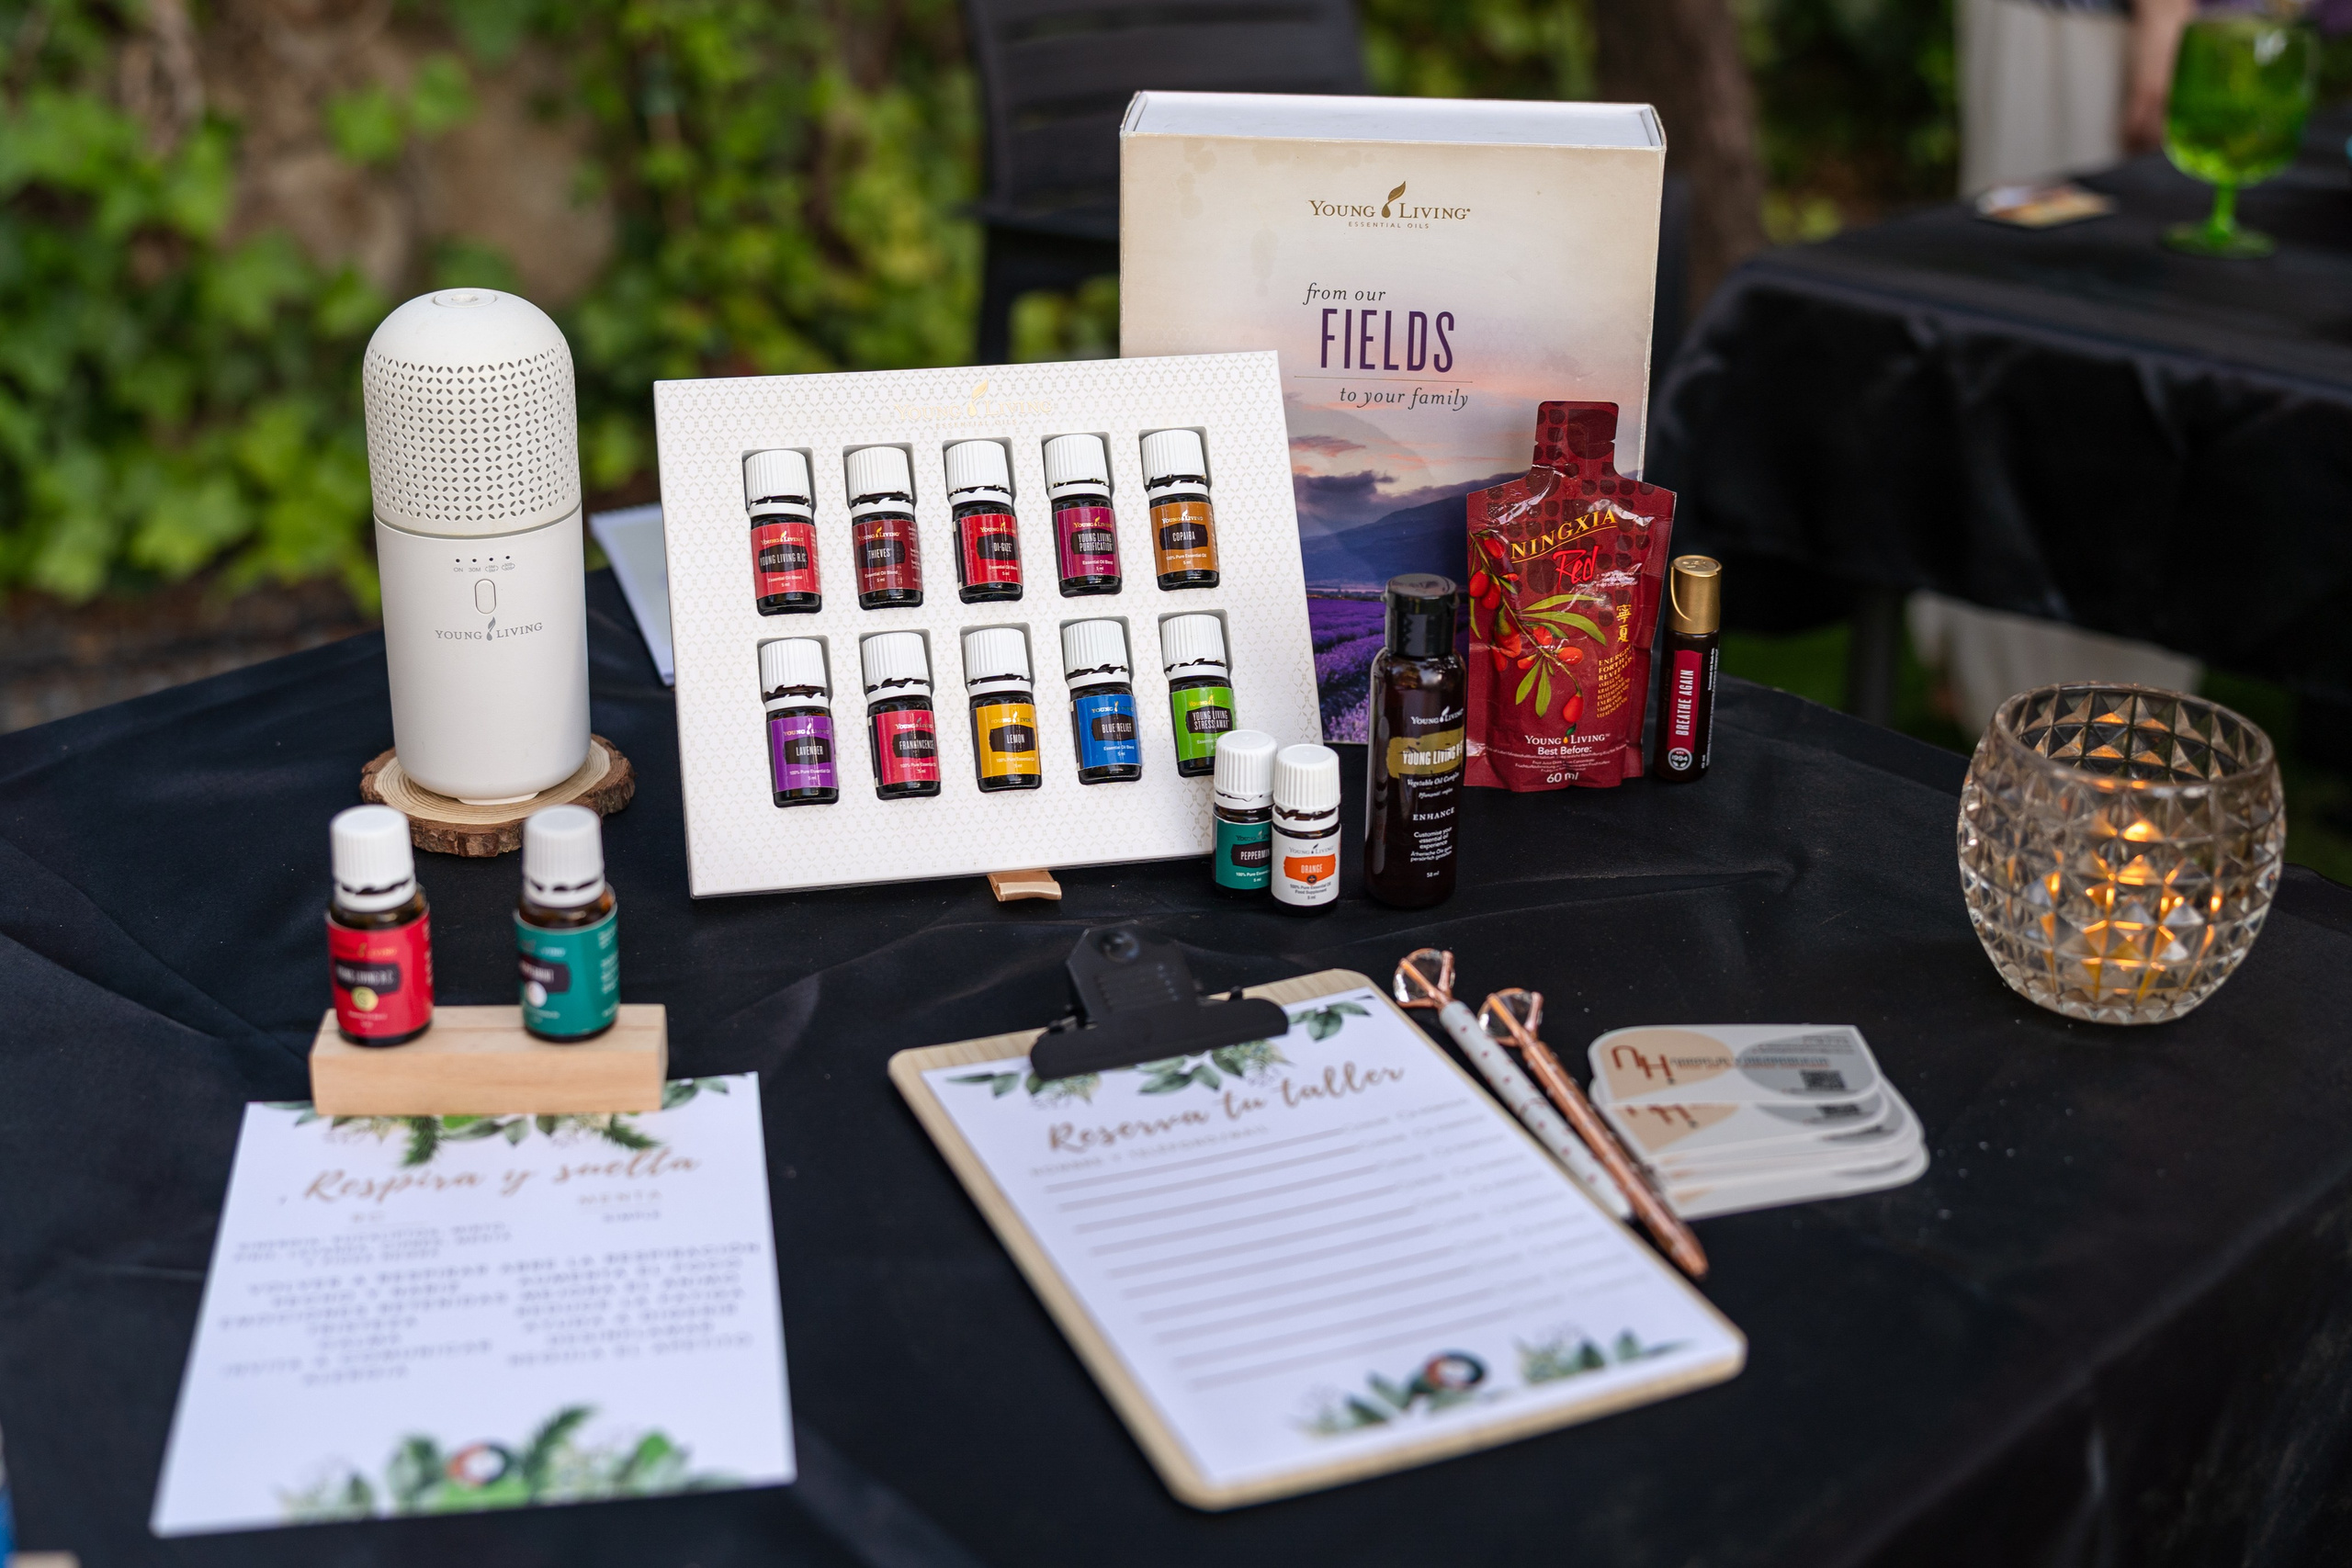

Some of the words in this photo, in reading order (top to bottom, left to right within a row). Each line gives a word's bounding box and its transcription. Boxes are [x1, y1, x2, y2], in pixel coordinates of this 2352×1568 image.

[1308, 199, 1376, 218] YOUNG
[1302, 282, 1347, 305] from
[1354, 290, 1386, 301] our
[1320, 308, 1455, 373] FIELDS
[1340, 388, 1357, 401] to
[1356, 392, 1406, 409] your
[1408, 387, 1468, 412] family
[894, 403, 962, 421] YOUNG
[983, 400, 1053, 415] LIVING
[935, 420, 989, 430] ESSENTIAL
[994, 419, 1017, 427] OILS
[1078, 533, 1097, 543] YOUNG
[1097, 533, 1112, 543] LIVING
[1172, 531, 1195, 542] COPAIBA
[1510, 508, 1618, 559] NINGXIA
[760, 555, 775, 566] YOUNG
[777, 552, 797, 563] LIVING
[1553, 546, 1599, 591] Red
[435, 630, 483, 640] YOUNG
[496, 622, 543, 638] LIVING
[1679, 670, 1694, 696] AGAIN
[1193, 711, 1211, 721] YOUNG
[1213, 710, 1228, 719] LIVING
[1411, 716, 1439, 726] YOUNG
[1675, 698, 1692, 736] BREATHE
[1102, 723, 1115, 733] BLUE
[1117, 723, 1132, 732] RELIEF
[1194, 720, 1214, 730] STRESS
[1007, 735, 1025, 744] LEMON
[1525, 735, 1562, 746] YOUNG
[796, 746, 823, 756] LAVENDER
[1403, 750, 1431, 766] YOUNG
[1433, 746, 1456, 765] LIVING
[1538, 746, 1557, 756] Best
[1560, 746, 1592, 755] Before:
[1407, 778, 1434, 788] Vegetable
[1433, 777, 1443, 786] Oil
[1546, 773, 1562, 784] 60
[1565, 773, 1579, 781] ml
[1412, 807, 1455, 821] ENHANCE
[1413, 829, 1442, 839] Customise
[1442, 827, 1453, 837] your
[1419, 836, 1442, 844] essential
[1419, 840, 1448, 851] experience
[1301, 863, 1323, 874] ORANGE
[1048, 1110, 1211, 1153] Reserva
[1212, 1090, 1267, 1121] tu
[1276, 1060, 1405, 1109] taller
[304, 1168, 484, 1205] Respira
[500, 1168, 535, 1197] y
